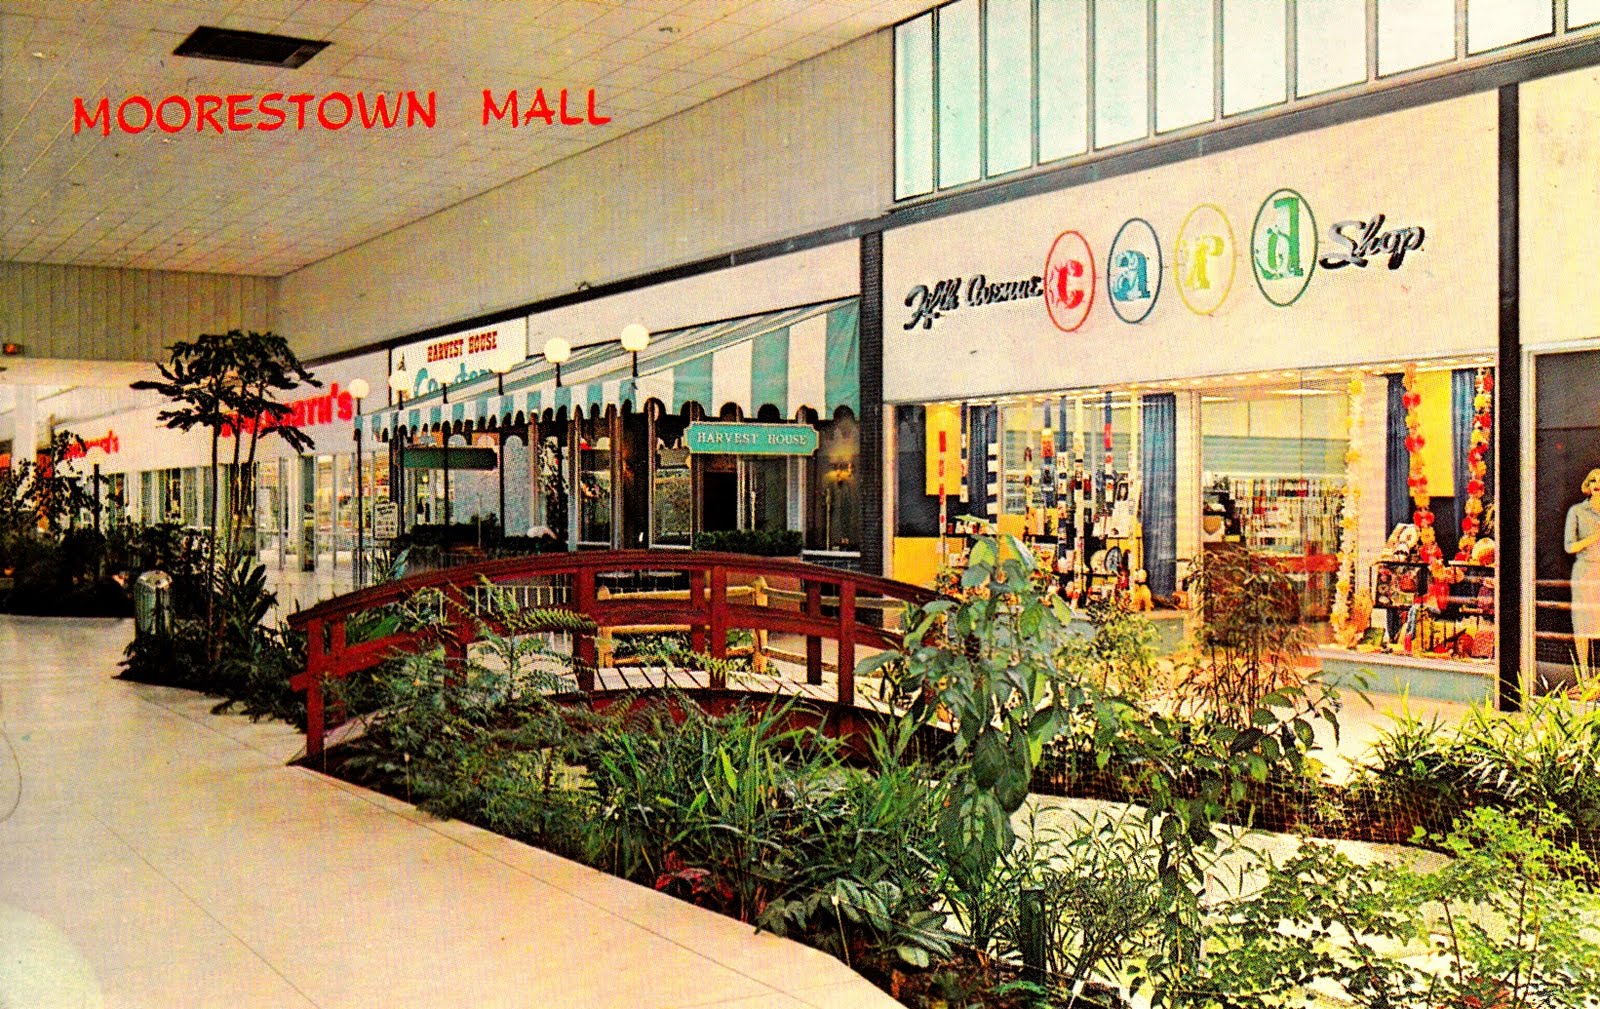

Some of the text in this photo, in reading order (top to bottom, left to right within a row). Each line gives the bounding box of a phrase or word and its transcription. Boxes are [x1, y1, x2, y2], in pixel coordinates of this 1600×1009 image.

[1319, 213, 1425, 270] Shop
[427, 330, 497, 363] HARVEST HOUSE
[697, 431, 807, 446] HARVEST HOUSE
